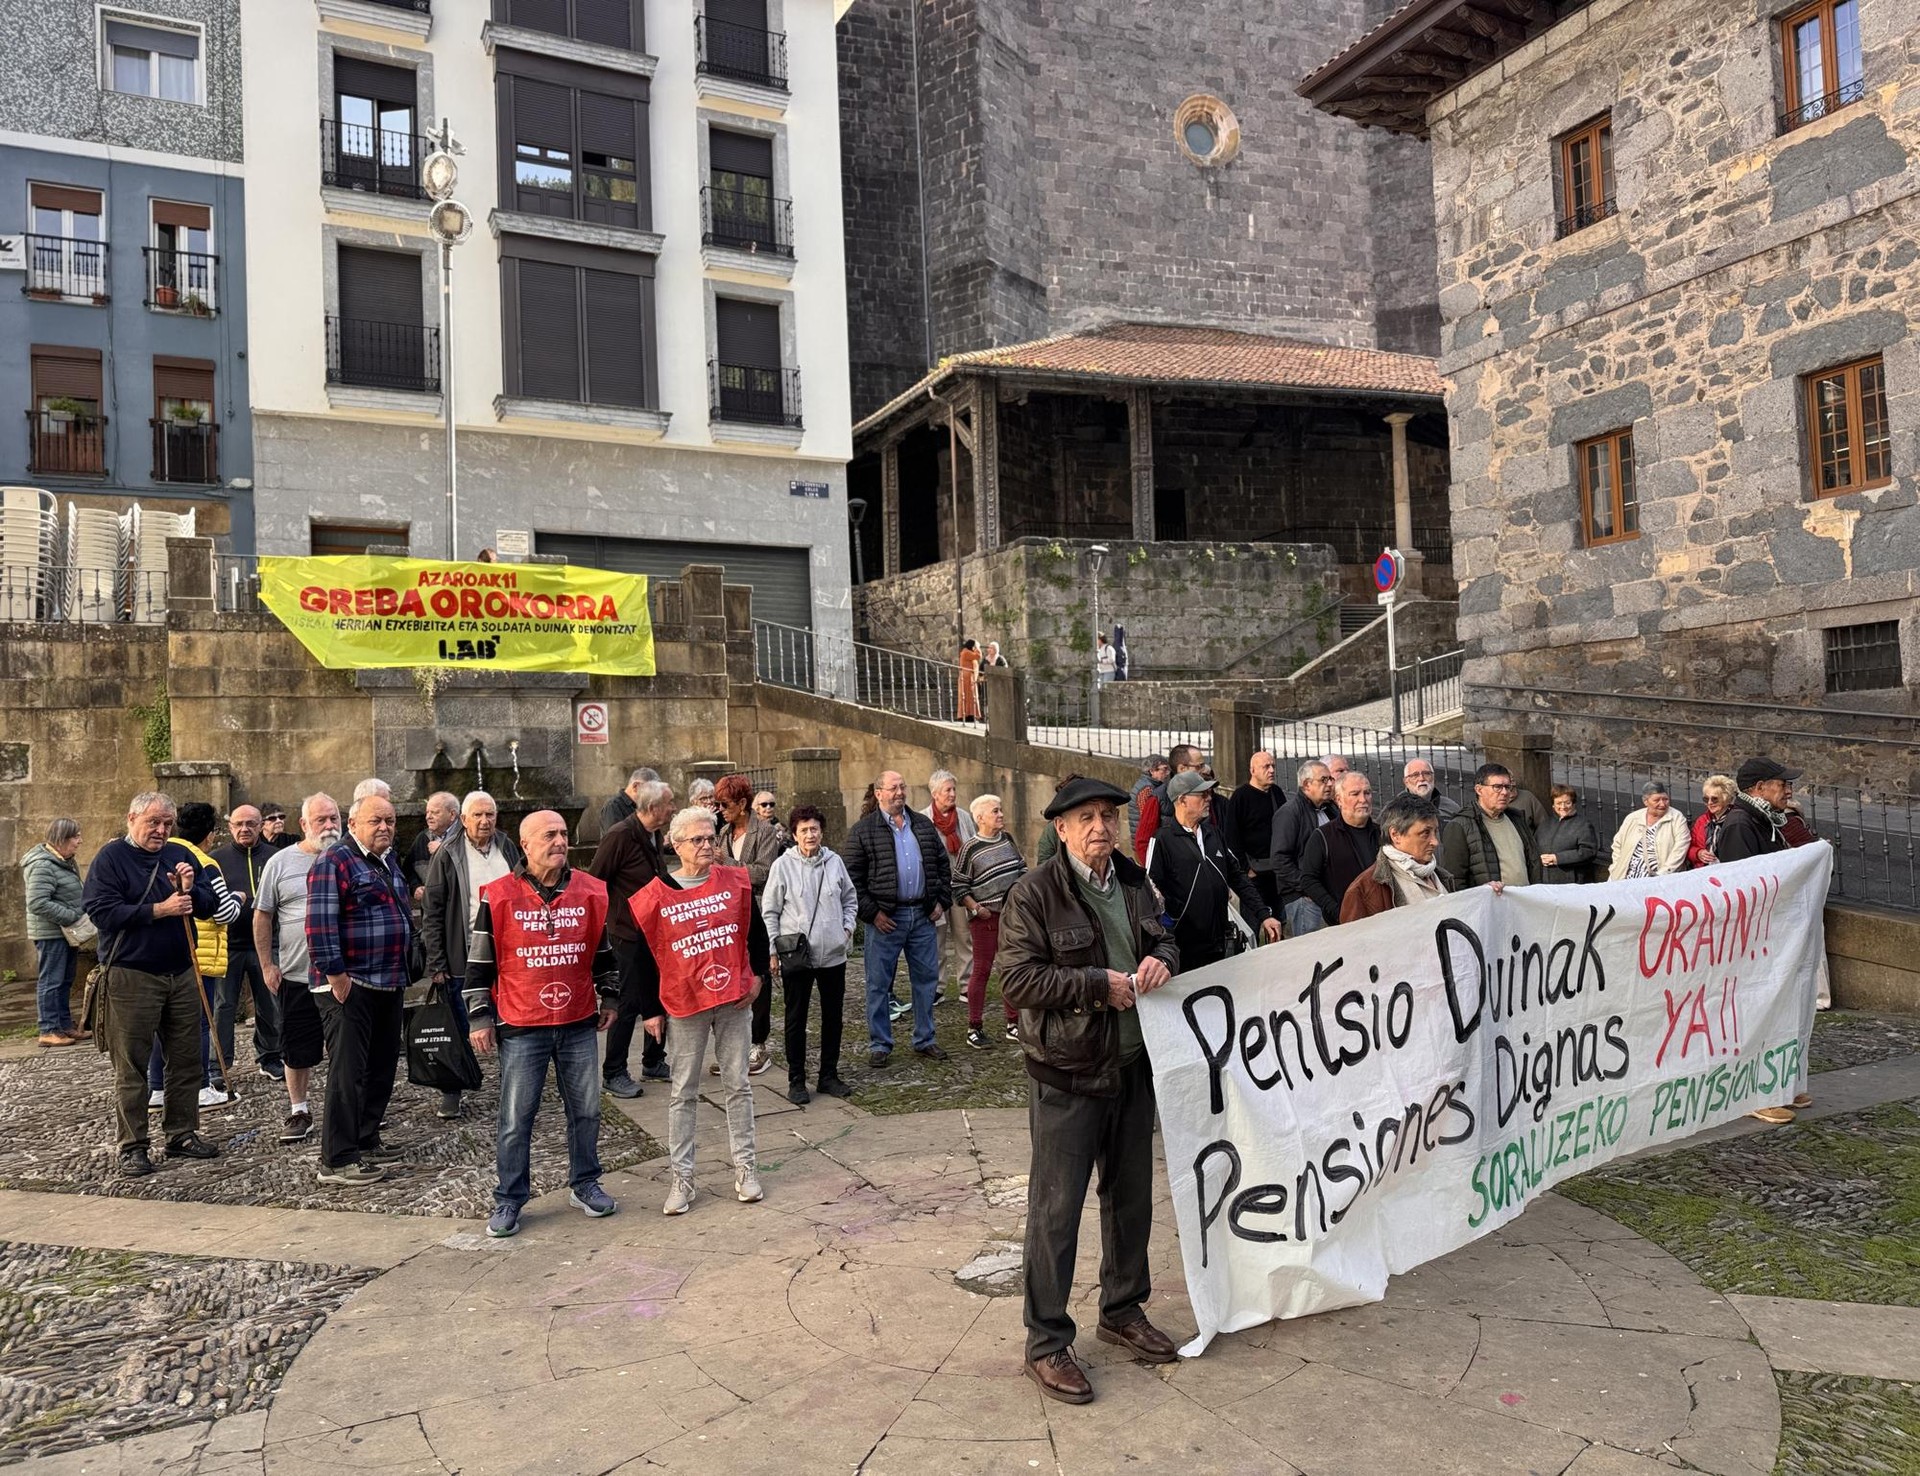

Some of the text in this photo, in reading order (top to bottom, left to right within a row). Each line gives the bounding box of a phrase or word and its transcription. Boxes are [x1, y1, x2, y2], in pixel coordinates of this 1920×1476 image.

[300, 586, 620, 622] GREBA OROKORRA
[332, 618, 381, 631] HERRIAN
[385, 619, 456, 632] ETXEBIZITZA
[459, 621, 478, 632] ETA
[482, 621, 532, 633] SOLDATA
[535, 623, 576, 635] DUINAK
[578, 624, 637, 635] DENONTZAT
[514, 906, 586, 921] GUTXENEKO
[660, 891, 732, 918] GUTXIENEKO
[670, 902, 727, 925] PENTSIOA
[516, 942, 587, 958] GUTXIENEKO
[671, 923, 739, 952] GUTXIENEKO
[682, 935, 734, 959] SOLDATA
[526, 954, 579, 968] SOLDATA
[1182, 956, 1414, 1114] Pentsio
[1193, 1015, 1629, 1268] Pensiones Dignas
[1468, 1095, 1628, 1228] SORALUZEKO
